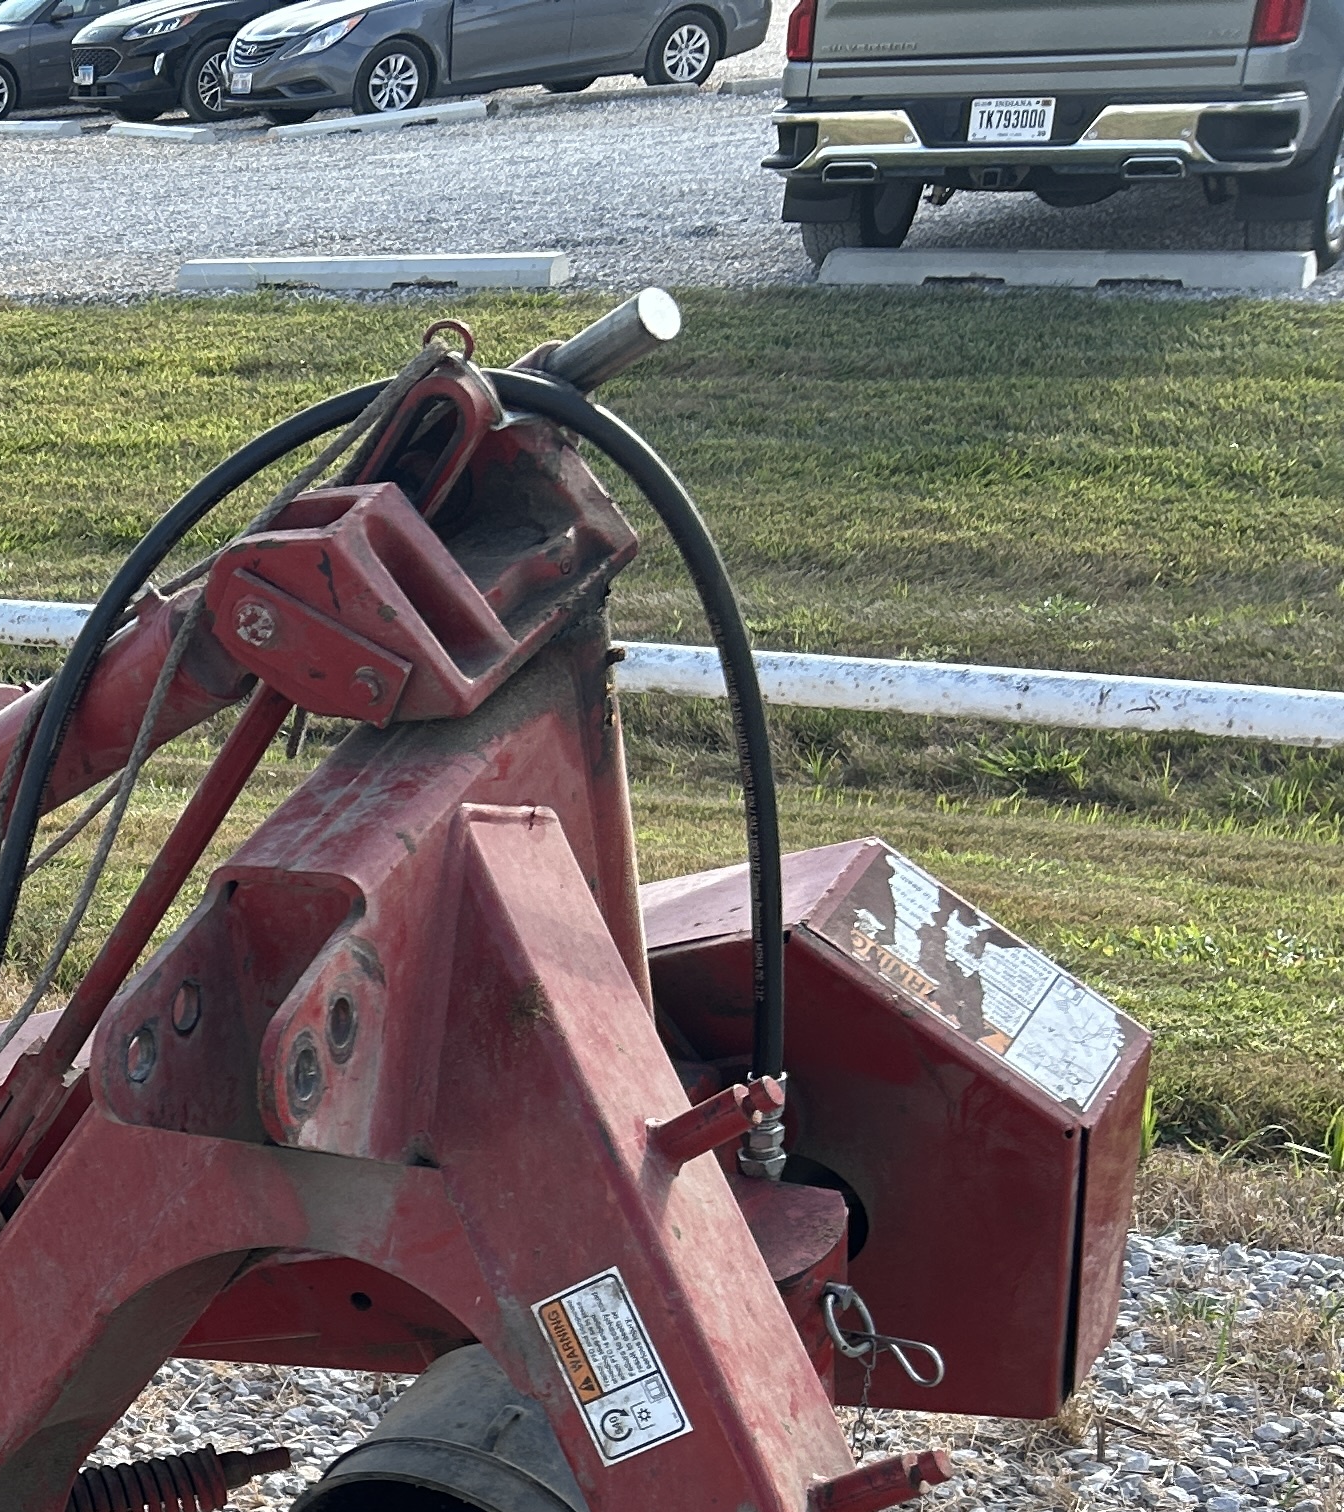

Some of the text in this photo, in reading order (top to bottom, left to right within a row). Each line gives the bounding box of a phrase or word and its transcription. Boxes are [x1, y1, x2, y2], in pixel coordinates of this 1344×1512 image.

[852, 934, 925, 993] RNING
[546, 1309, 584, 1373] WARNING
[601, 1312, 620, 1341] comply
[614, 1319, 629, 1342] death
